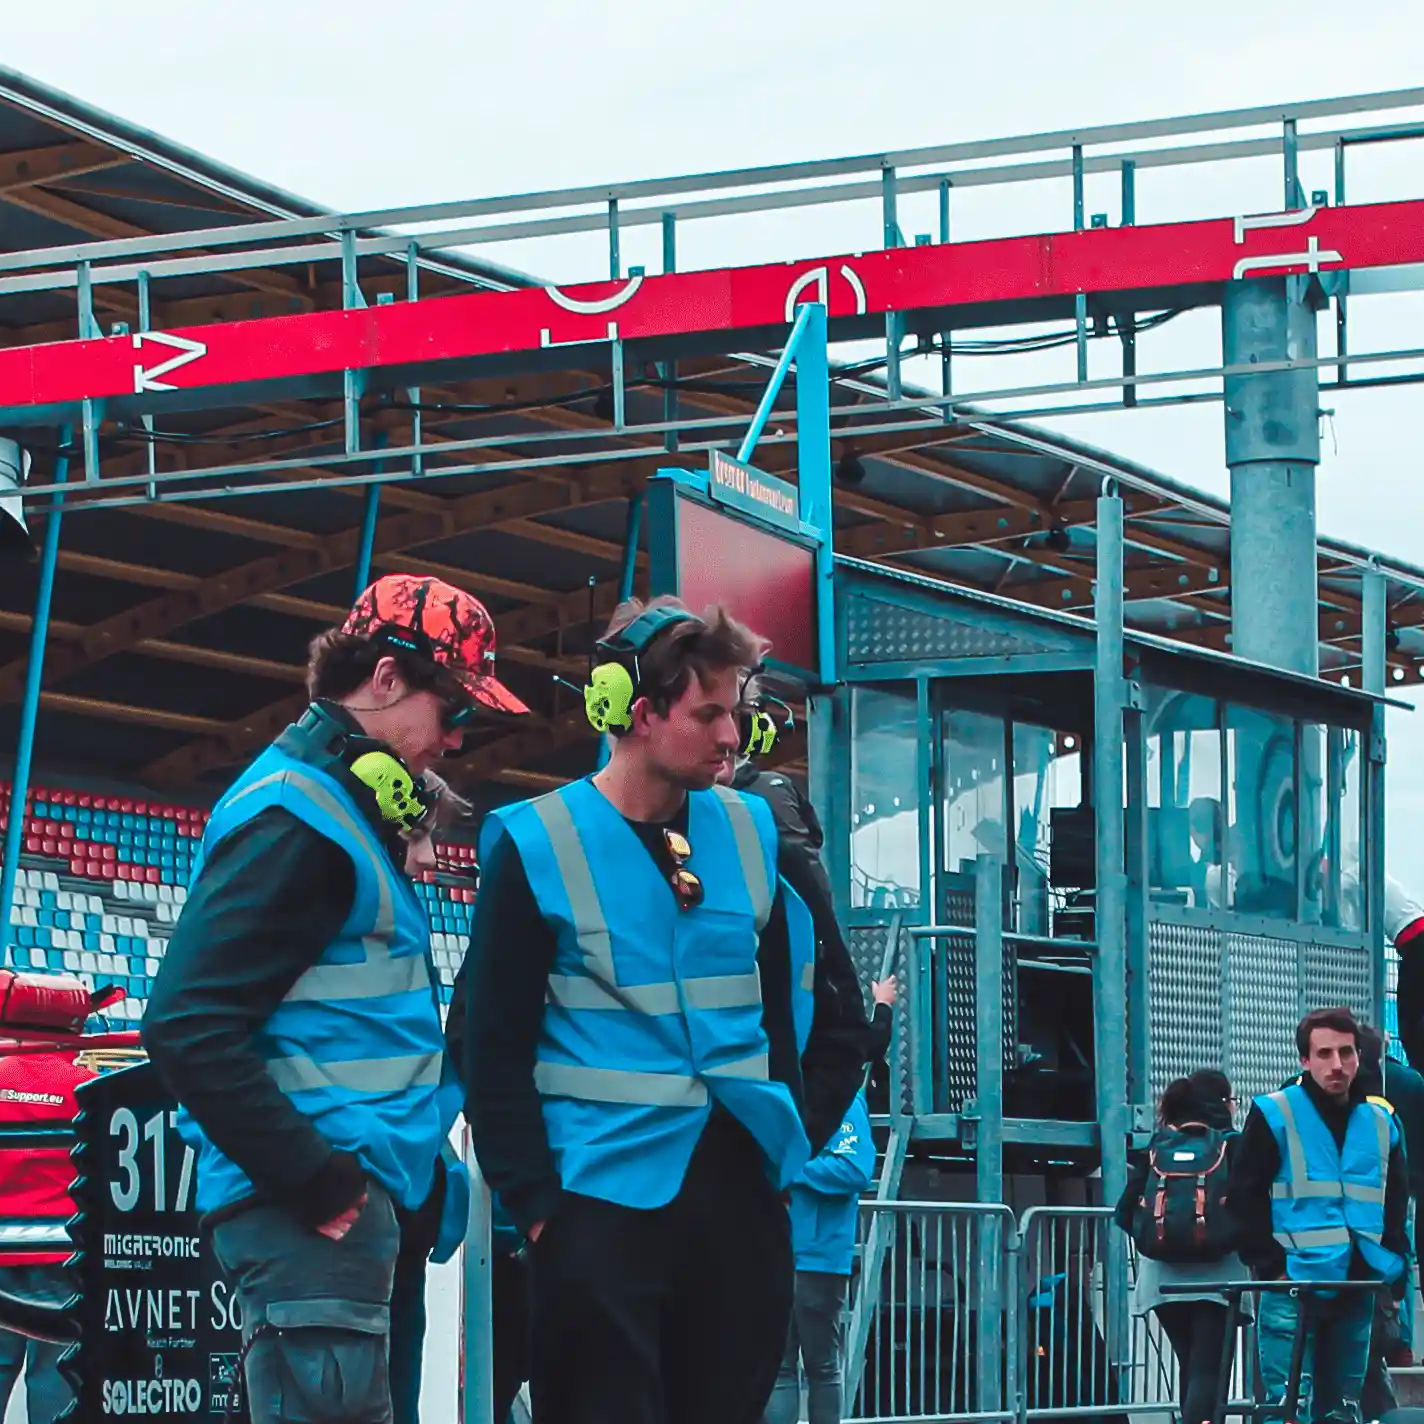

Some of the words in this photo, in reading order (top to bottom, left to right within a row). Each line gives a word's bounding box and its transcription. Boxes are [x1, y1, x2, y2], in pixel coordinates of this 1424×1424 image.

[109, 1107, 195, 1212] 317
[104, 1288, 200, 1331] AVNET
[102, 1378, 202, 1415] SOLECTRO
